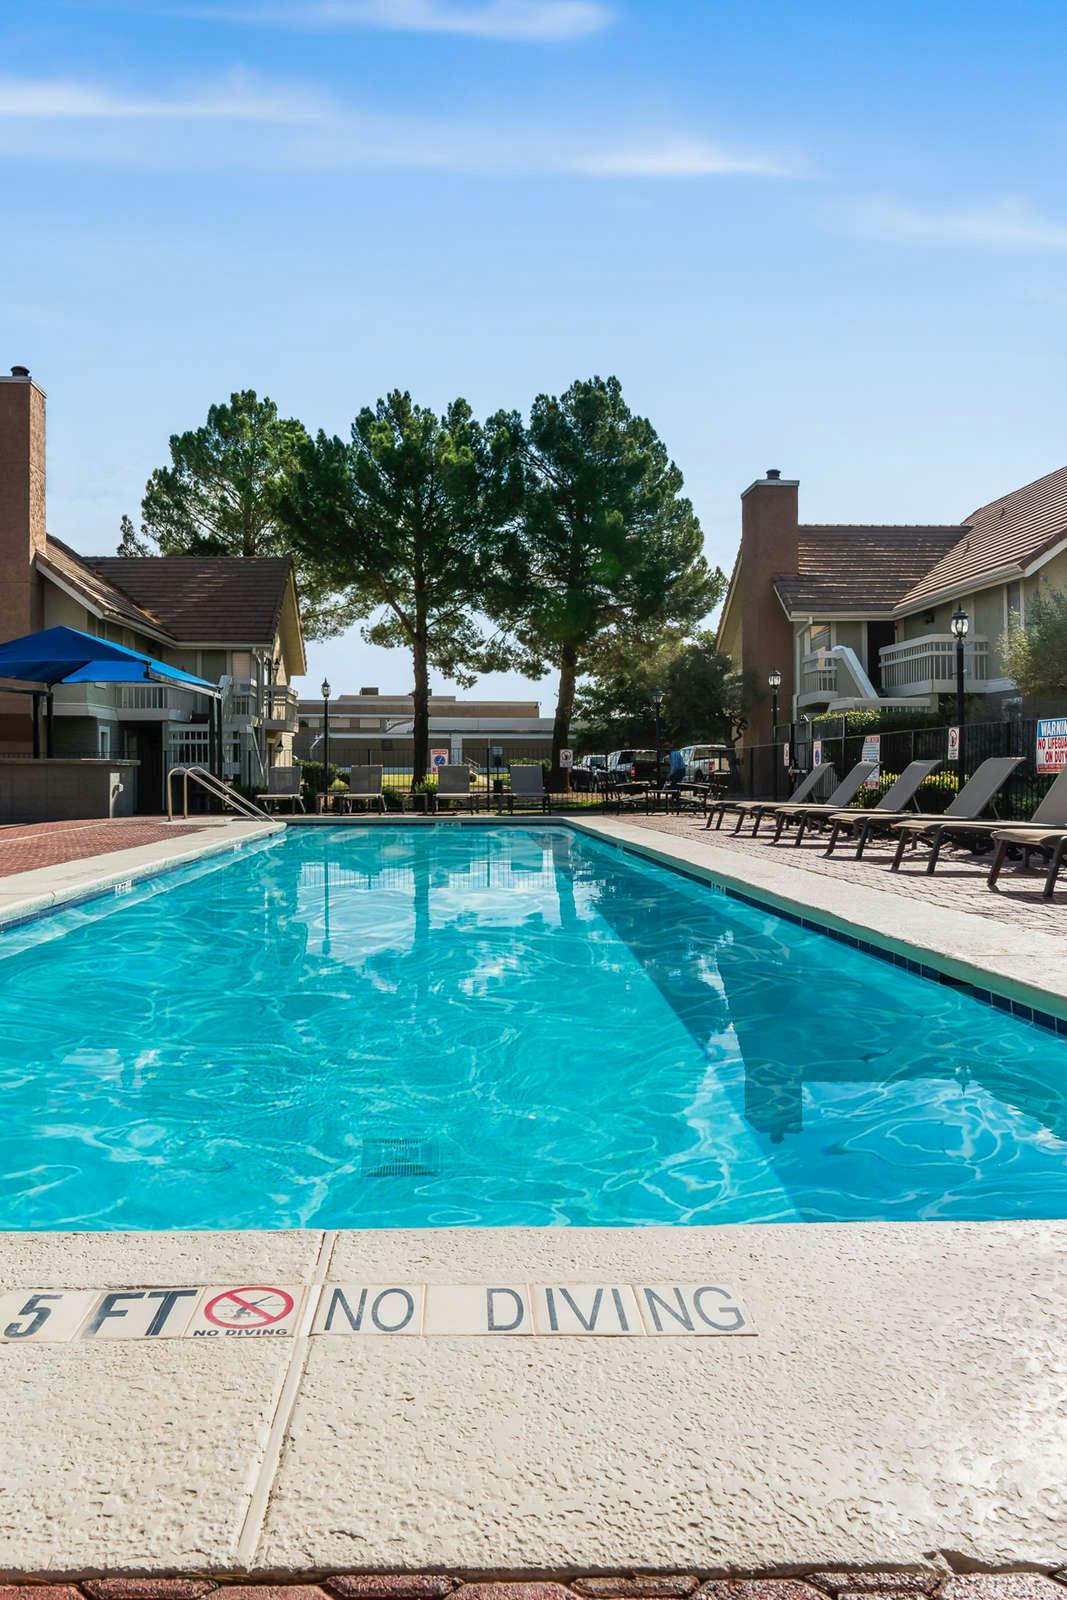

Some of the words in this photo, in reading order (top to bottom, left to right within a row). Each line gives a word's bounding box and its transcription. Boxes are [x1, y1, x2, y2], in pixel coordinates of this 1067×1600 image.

[1038, 738, 1046, 750] NO
[1045, 750, 1053, 762] ON
[4, 1294, 63, 1339] 5
[84, 1290, 198, 1338] FT
[324, 1287, 415, 1332] NO
[486, 1286, 746, 1332] DIVING
[225, 1328, 289, 1337] DIVING
